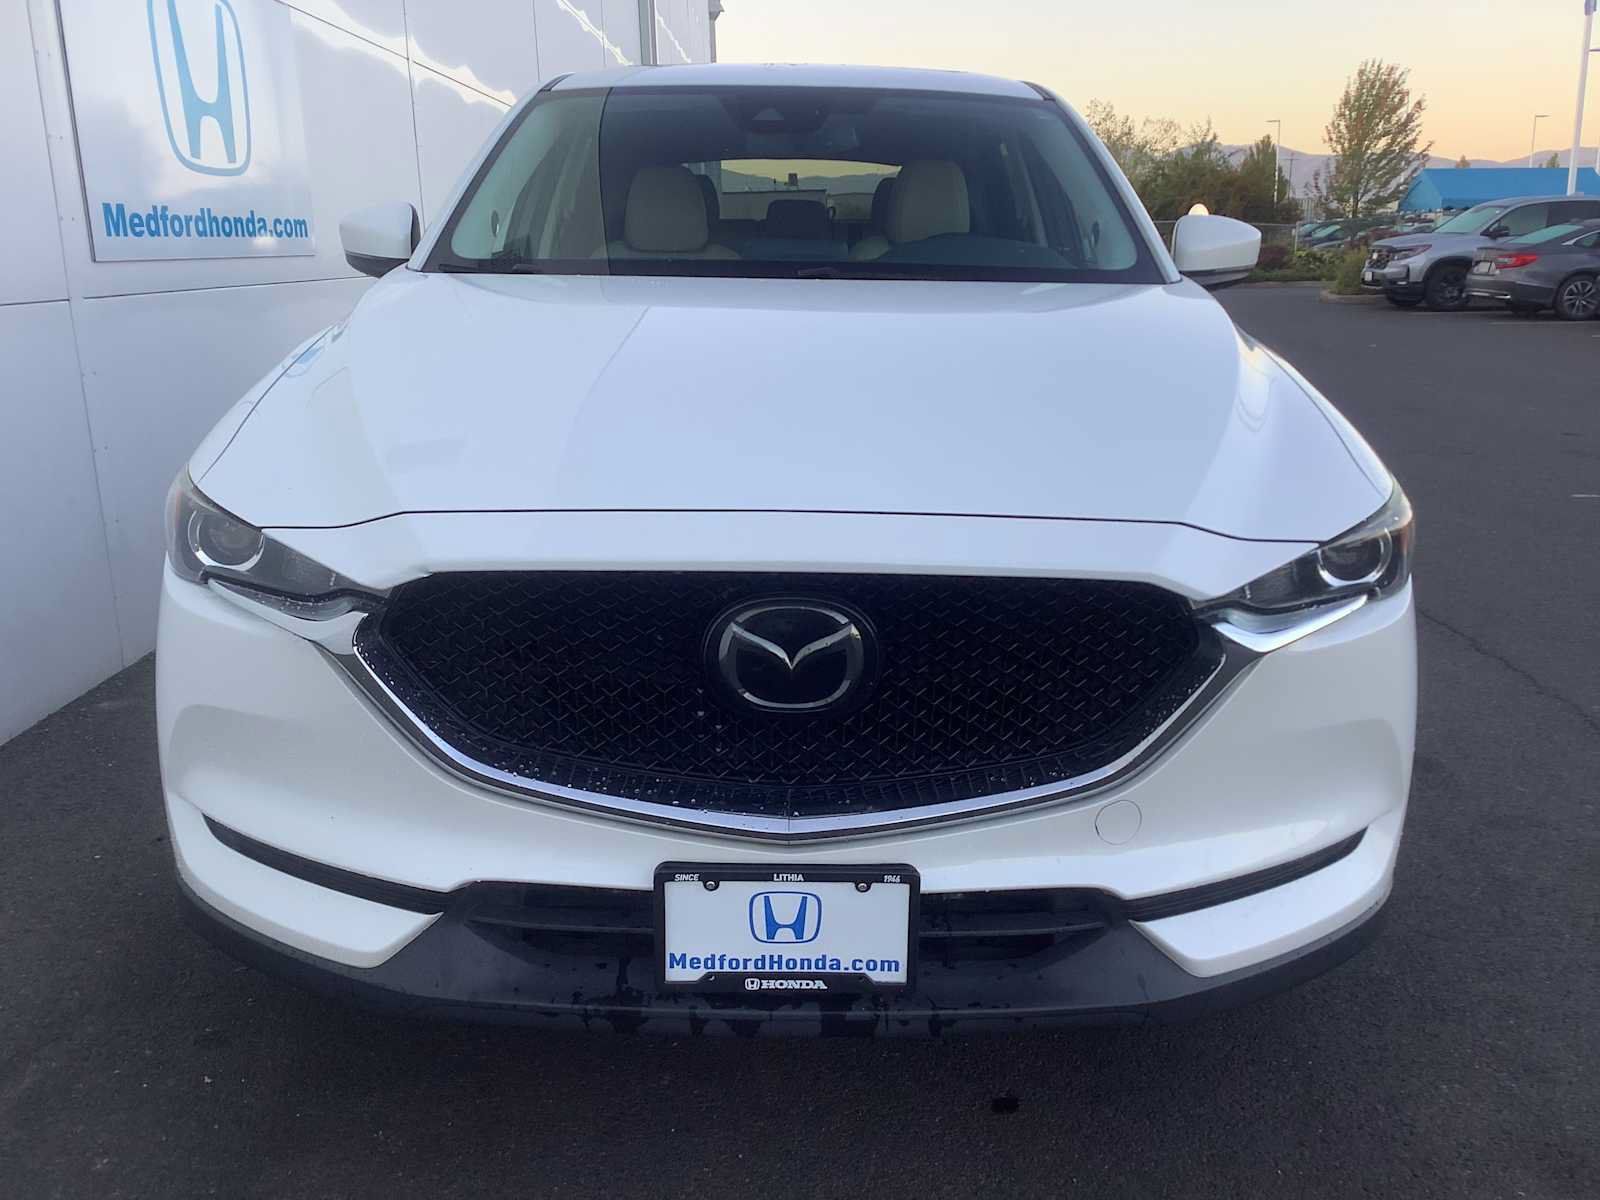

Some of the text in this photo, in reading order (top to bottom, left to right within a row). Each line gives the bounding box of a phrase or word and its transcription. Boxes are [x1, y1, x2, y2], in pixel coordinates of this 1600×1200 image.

[102, 202, 308, 238] Medfordhonda.com
[674, 873, 699, 882] SINCE
[773, 873, 804, 882] LITHIA
[669, 953, 900, 972] MedfordHonda.com
[761, 979, 828, 990] HONDA
